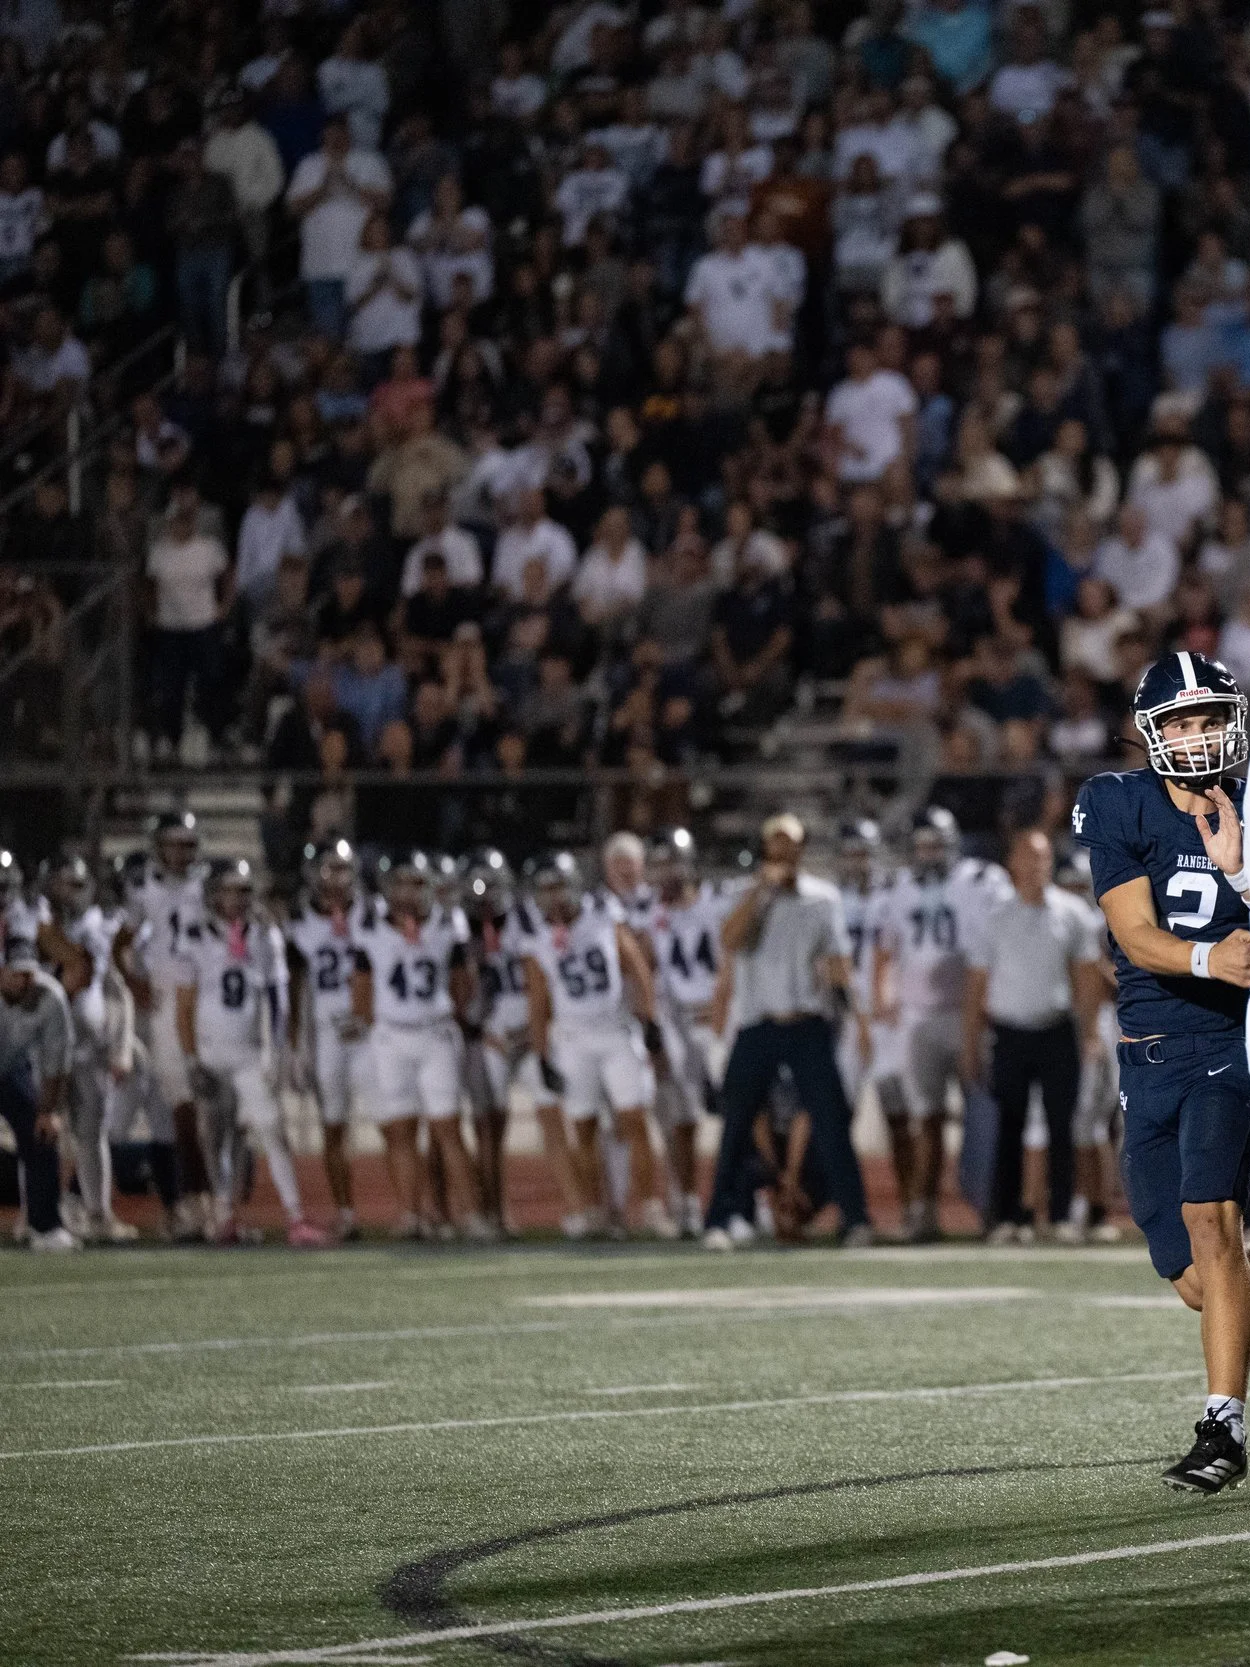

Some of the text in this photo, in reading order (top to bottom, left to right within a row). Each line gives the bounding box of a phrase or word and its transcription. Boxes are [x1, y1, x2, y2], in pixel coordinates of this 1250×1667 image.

[1179, 687, 1210, 698] Riddell
[1165, 870, 1219, 932] 2
[389, 955, 437, 1001] 43
[558, 946, 611, 998] 59
